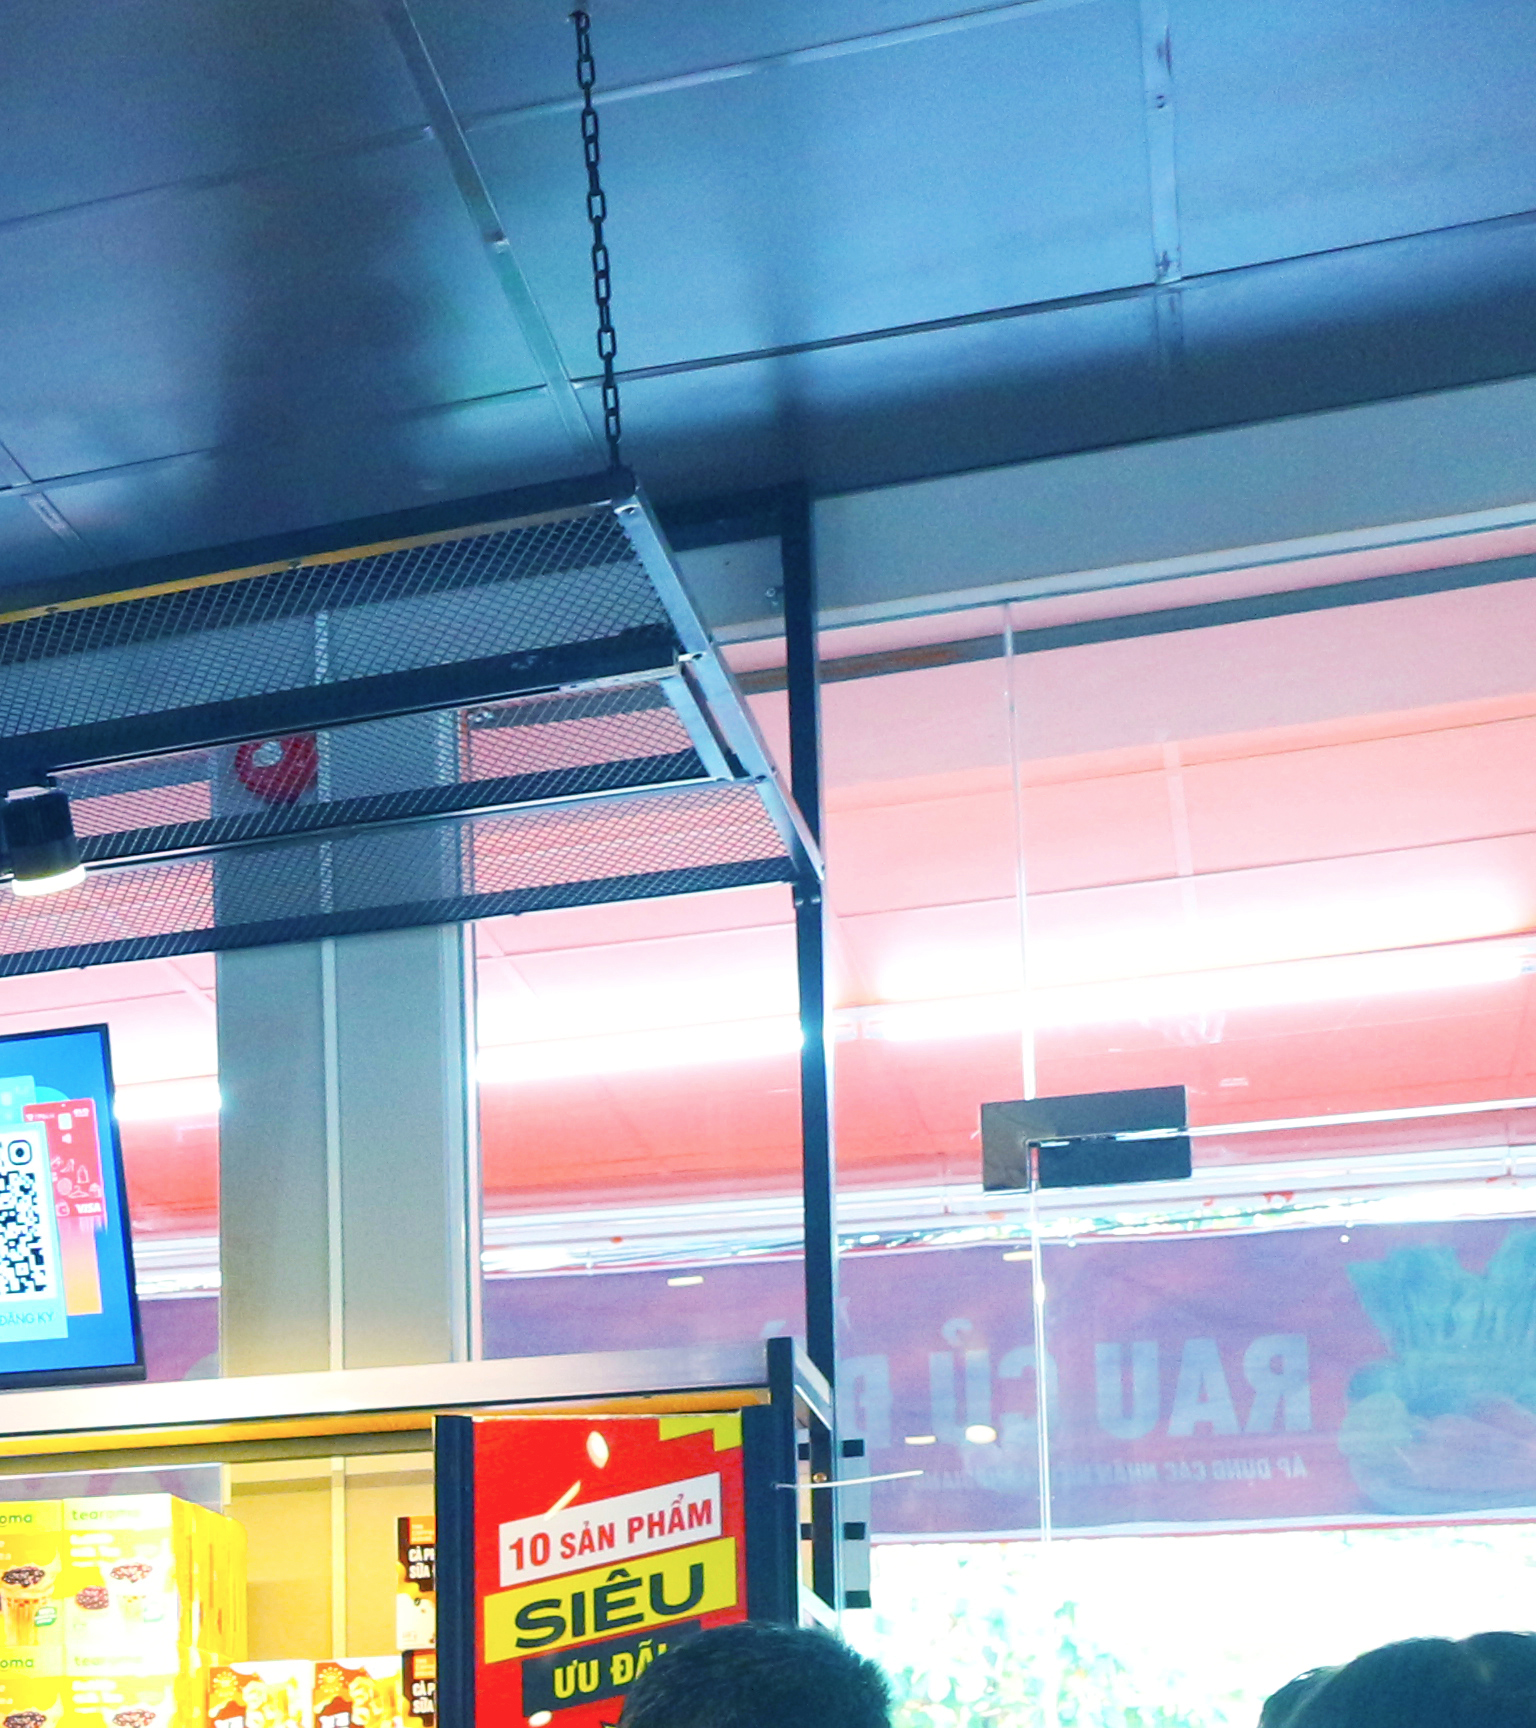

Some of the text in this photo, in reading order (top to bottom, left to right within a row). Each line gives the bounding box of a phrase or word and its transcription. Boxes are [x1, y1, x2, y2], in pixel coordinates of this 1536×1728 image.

[75, 1202, 101, 1214] VISA
[508, 1491, 714, 1571] 10 SẢN PHẨM
[514, 1563, 706, 1649] SIÊU
[554, 1655, 599, 1700] ƯU
